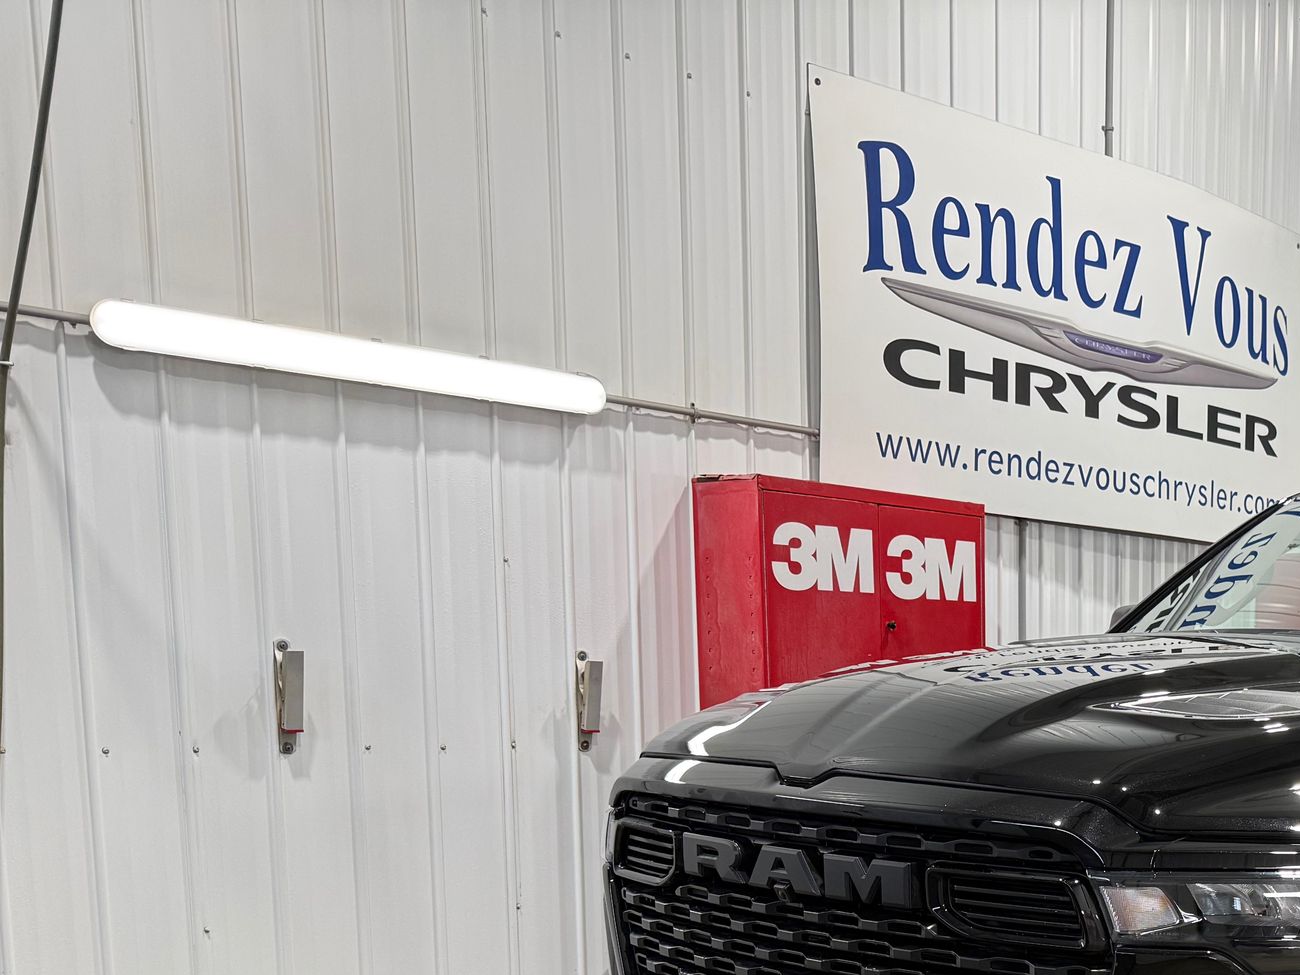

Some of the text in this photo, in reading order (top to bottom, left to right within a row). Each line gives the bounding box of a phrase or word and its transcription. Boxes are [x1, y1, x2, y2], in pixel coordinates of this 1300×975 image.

[858, 140, 1289, 377] Rendez Vous
[1074, 337, 1152, 361] CHRYSLER
[883, 338, 1278, 458] CHRYSLER
[771, 522, 977, 603] 3M 3M
[682, 831, 914, 910] RAM
